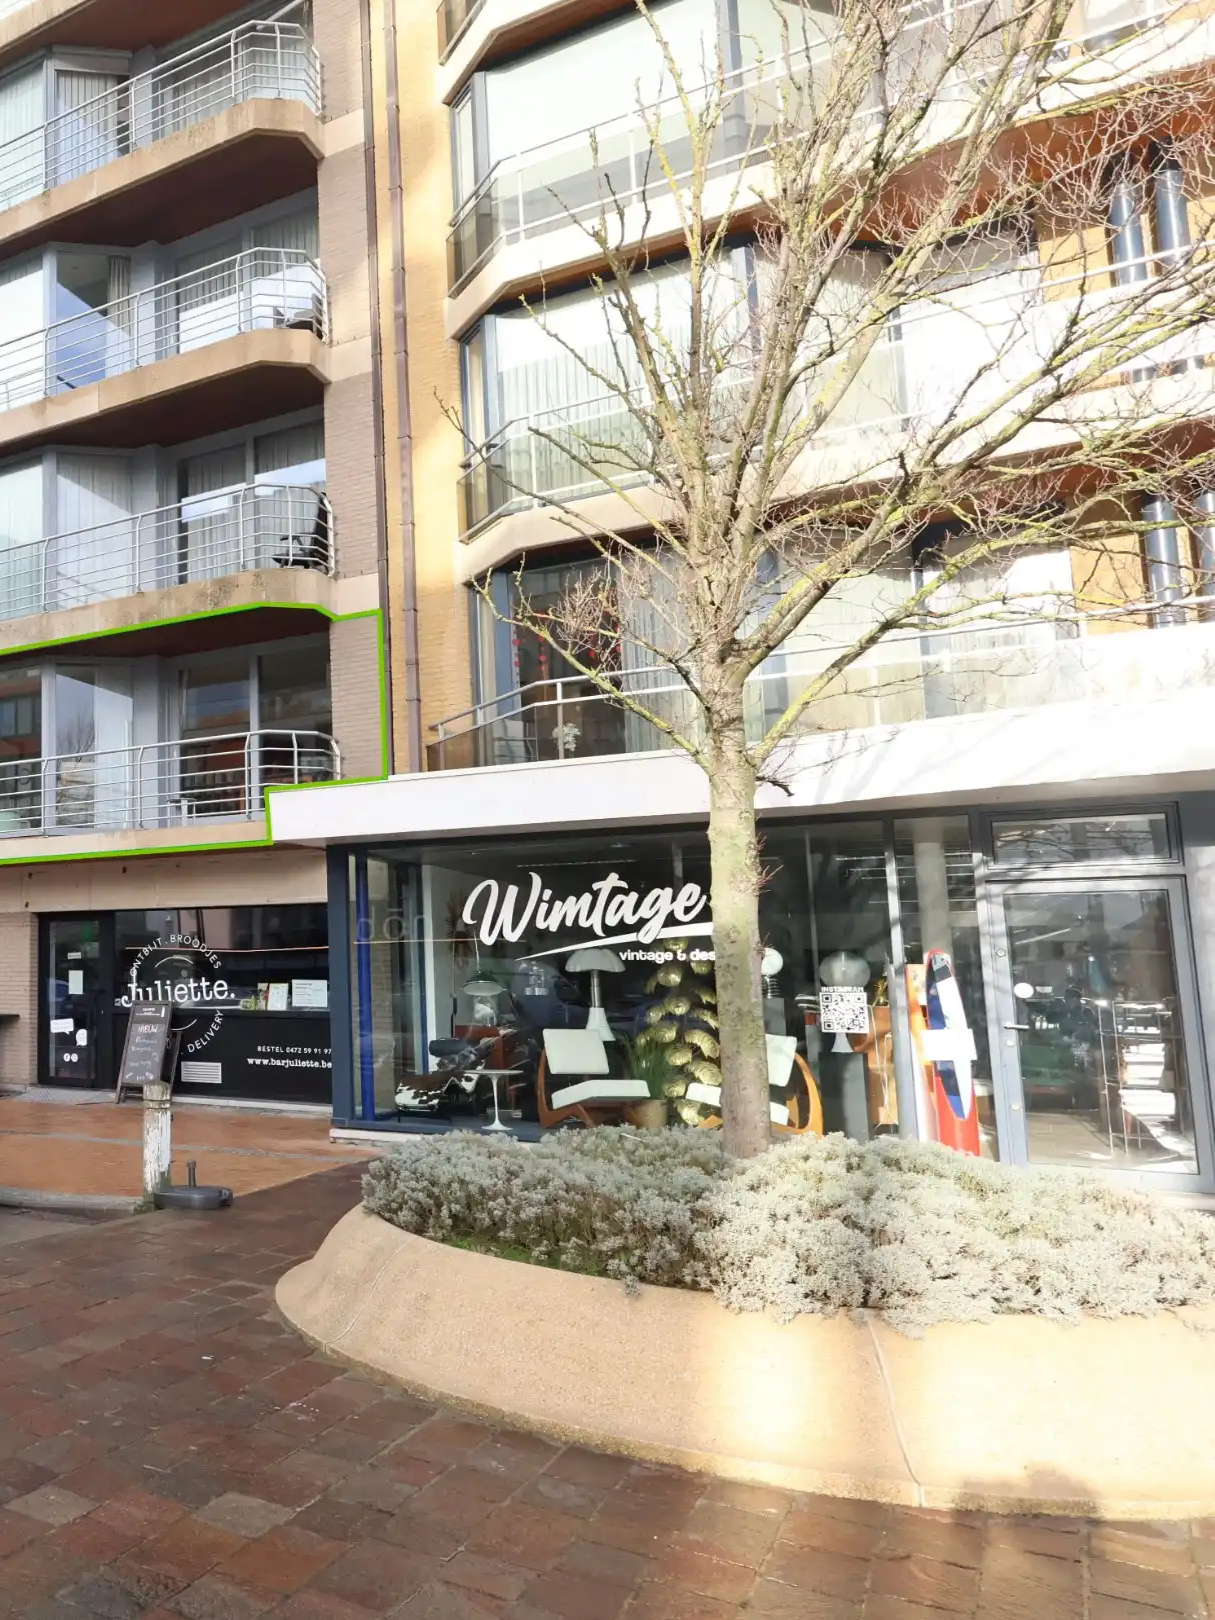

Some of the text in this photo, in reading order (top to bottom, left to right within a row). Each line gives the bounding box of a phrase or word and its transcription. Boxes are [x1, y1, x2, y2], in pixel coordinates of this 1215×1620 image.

[462, 872, 707, 946] Wimtage
[169, 933, 222, 970] BROODJES
[619, 948, 674, 964] vintage
[676, 949, 687, 962] &
[187, 1009, 224, 1053] DELIVERY
[246, 1056, 333, 1069] www.barjuliette.be
[256, 1045, 284, 1054] BESTEL
[285, 1046, 302, 1055] 0472
[303, 1047, 312, 1055] 59
[313, 1047, 322, 1055] 91
